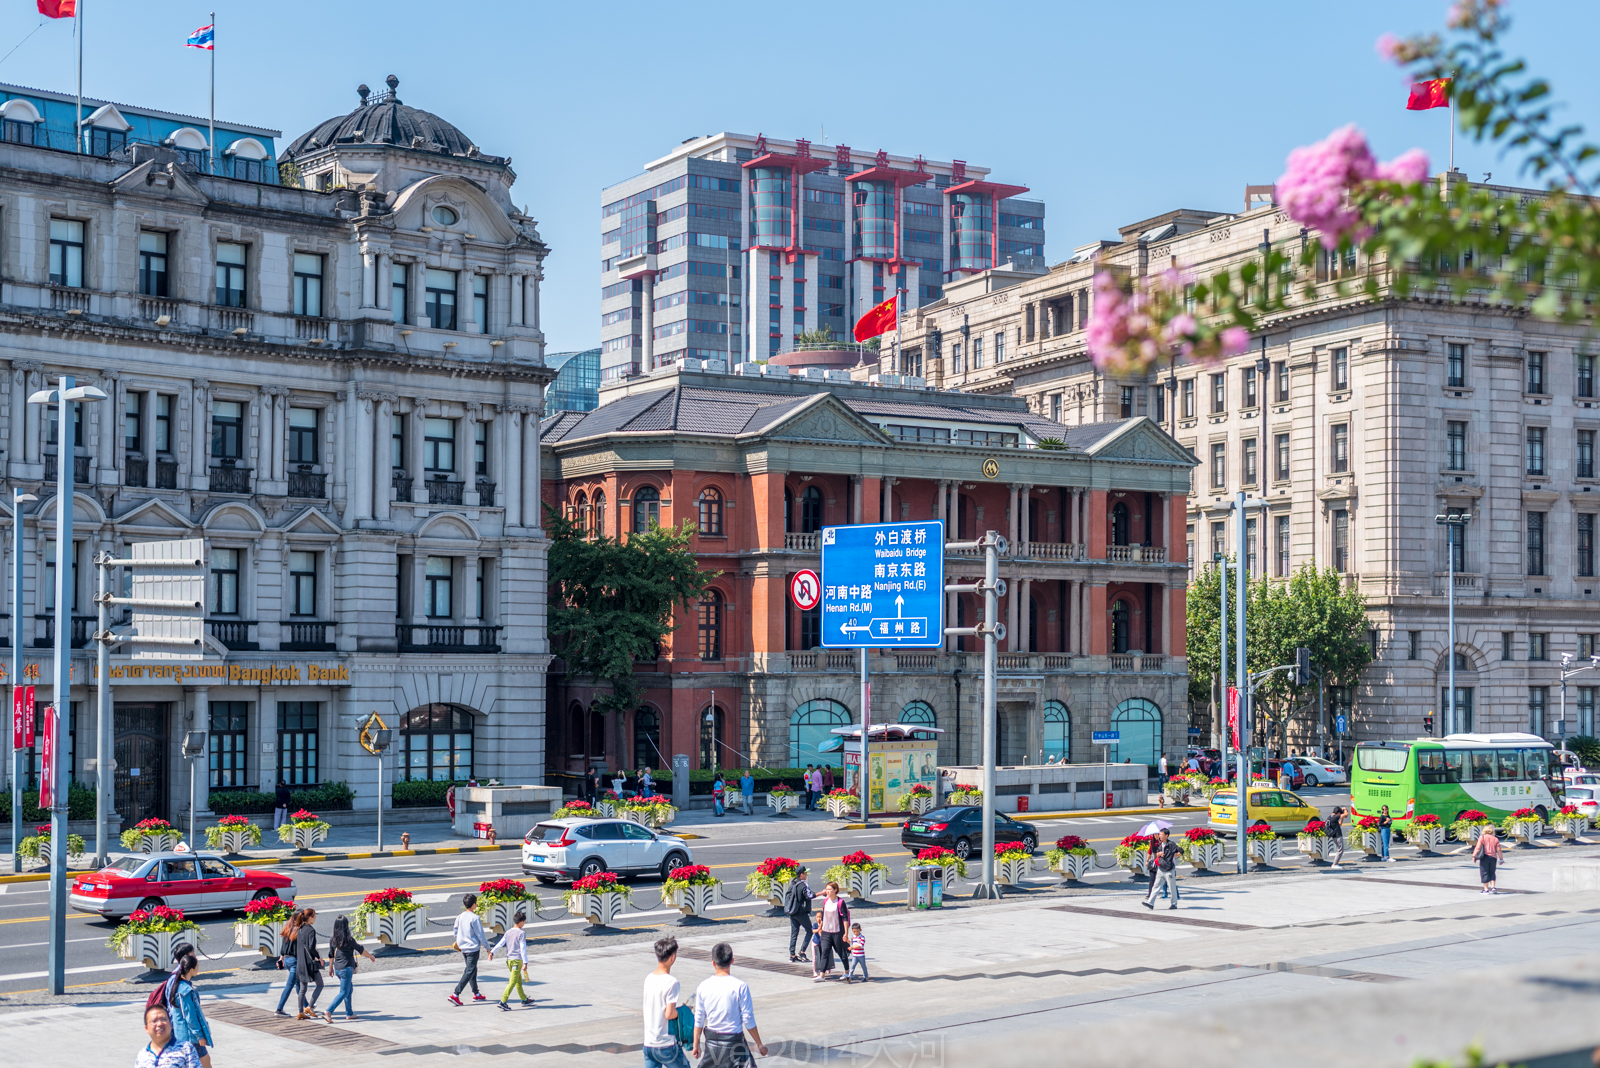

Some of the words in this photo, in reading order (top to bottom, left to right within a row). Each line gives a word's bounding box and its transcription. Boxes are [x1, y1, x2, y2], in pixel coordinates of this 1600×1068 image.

[755, 132, 966, 183] 久事商务大厦
[875, 529, 927, 545] 外白渡桥
[875, 549, 903, 558] Waibaidu
[905, 548, 927, 559] Bridge
[874, 562, 926, 578] 南京东路
[825, 584, 873, 601] 河南中路
[874, 581, 902, 593] Nanjing
[904, 580, 926, 591] Rd.(E)
[825, 603, 848, 613] Henan
[849, 602, 873, 613] Rd.(M)
[848, 618, 857, 627] 40
[879, 621, 921, 635] 福州路
[847, 631, 857, 640] 17
[229, 665, 301, 684] Bangkok
[308, 665, 349, 681] Bank
